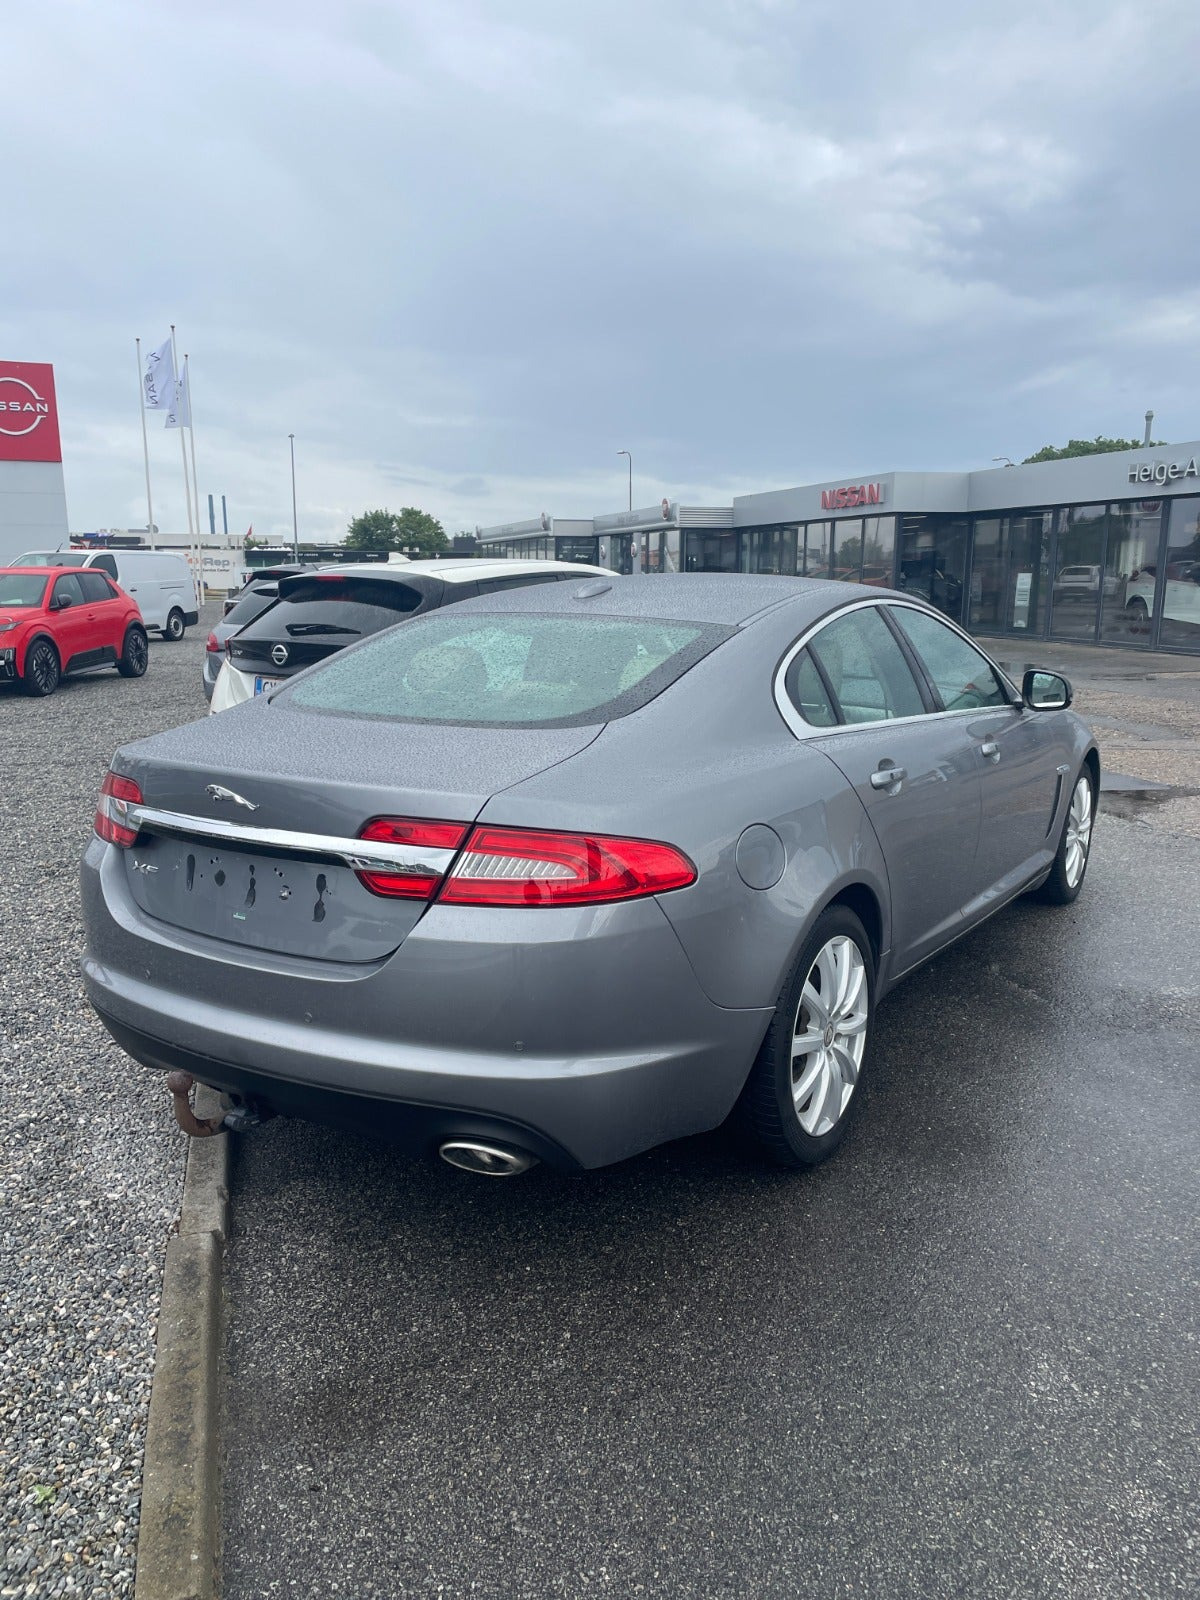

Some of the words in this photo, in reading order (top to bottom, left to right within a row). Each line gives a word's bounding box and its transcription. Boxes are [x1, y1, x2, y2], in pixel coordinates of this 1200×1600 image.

[1128, 461, 1179, 486] Helge
[821, 483, 880, 509] NISSAN
[132, 860, 159, 875] XF
